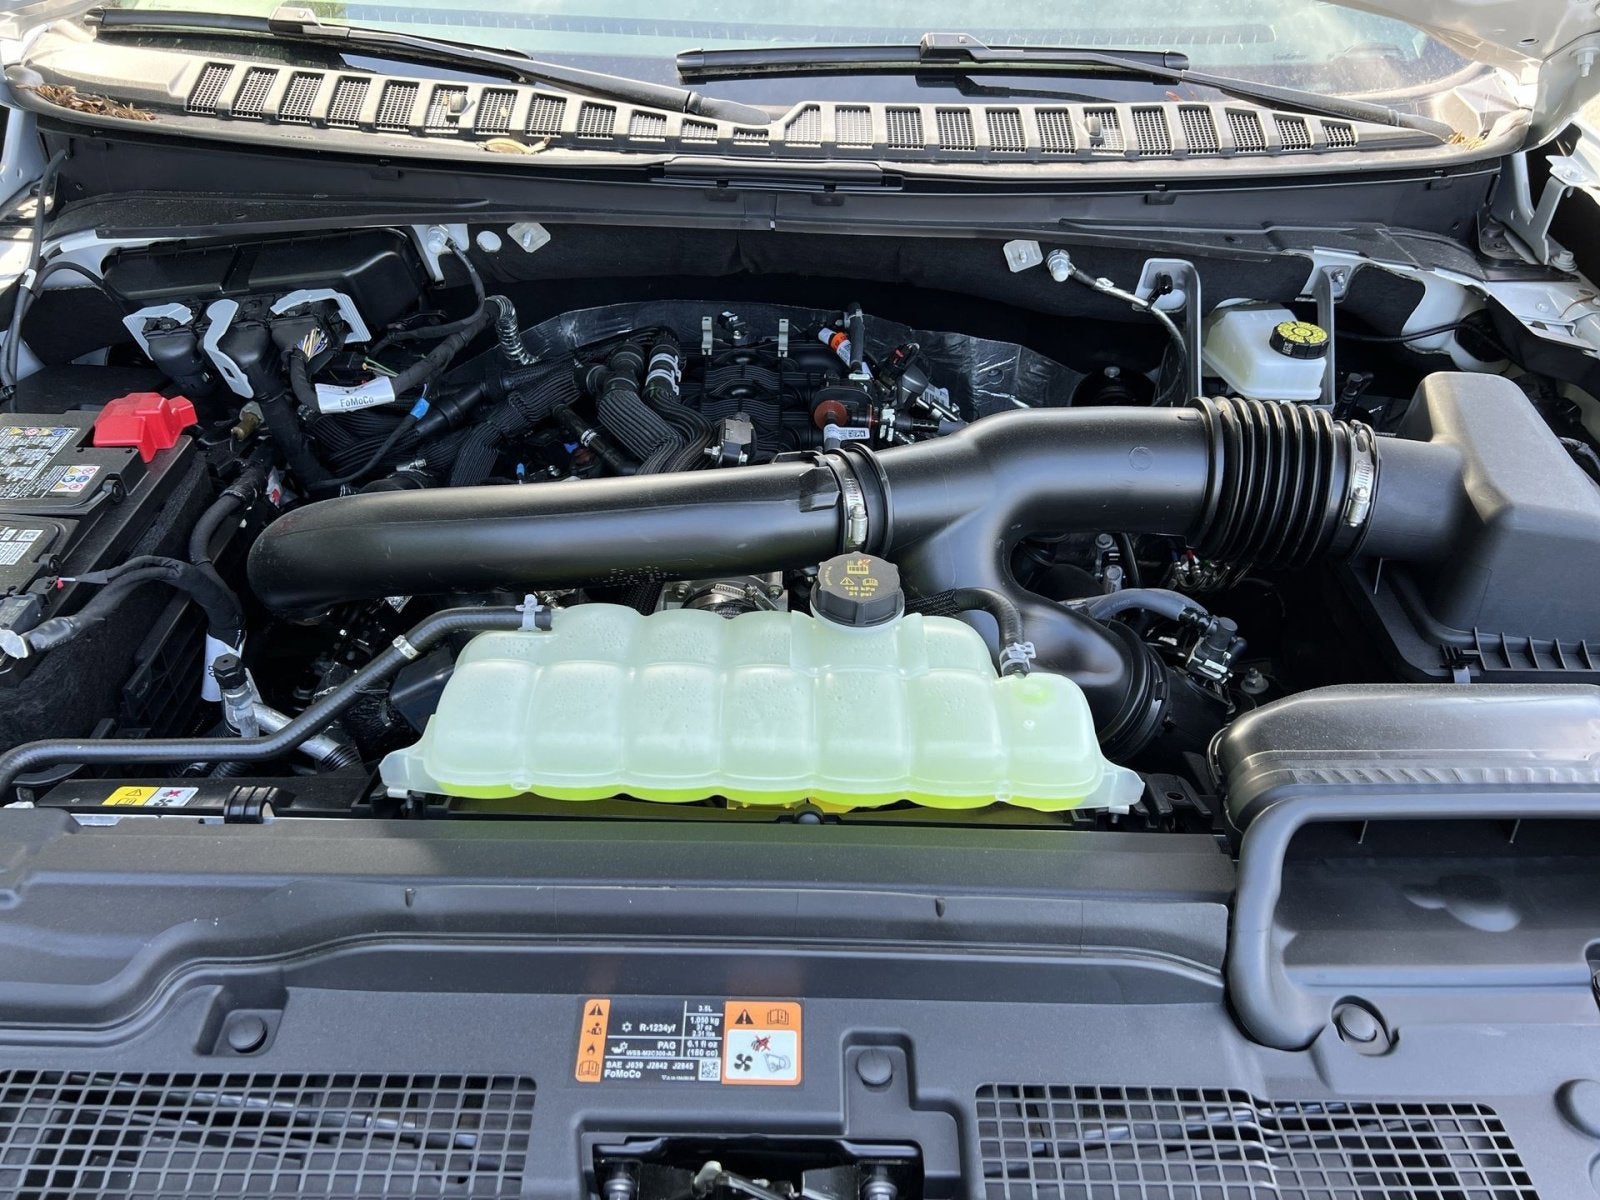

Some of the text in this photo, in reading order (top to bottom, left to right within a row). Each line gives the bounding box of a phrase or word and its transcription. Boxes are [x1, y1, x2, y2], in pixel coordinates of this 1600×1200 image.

[339, 395, 374, 408] FoMoCo
[710, 1016, 720, 1026] kg
[639, 1023, 677, 1034] R-1234yf
[657, 1041, 677, 1050] PAG
[687, 1040, 699, 1048] 6.1
[700, 1040, 707, 1048] fl
[705, 1049, 719, 1058] cc)
[605, 1061, 623, 1069] SAE
[604, 1069, 642, 1079] FoMoCo
